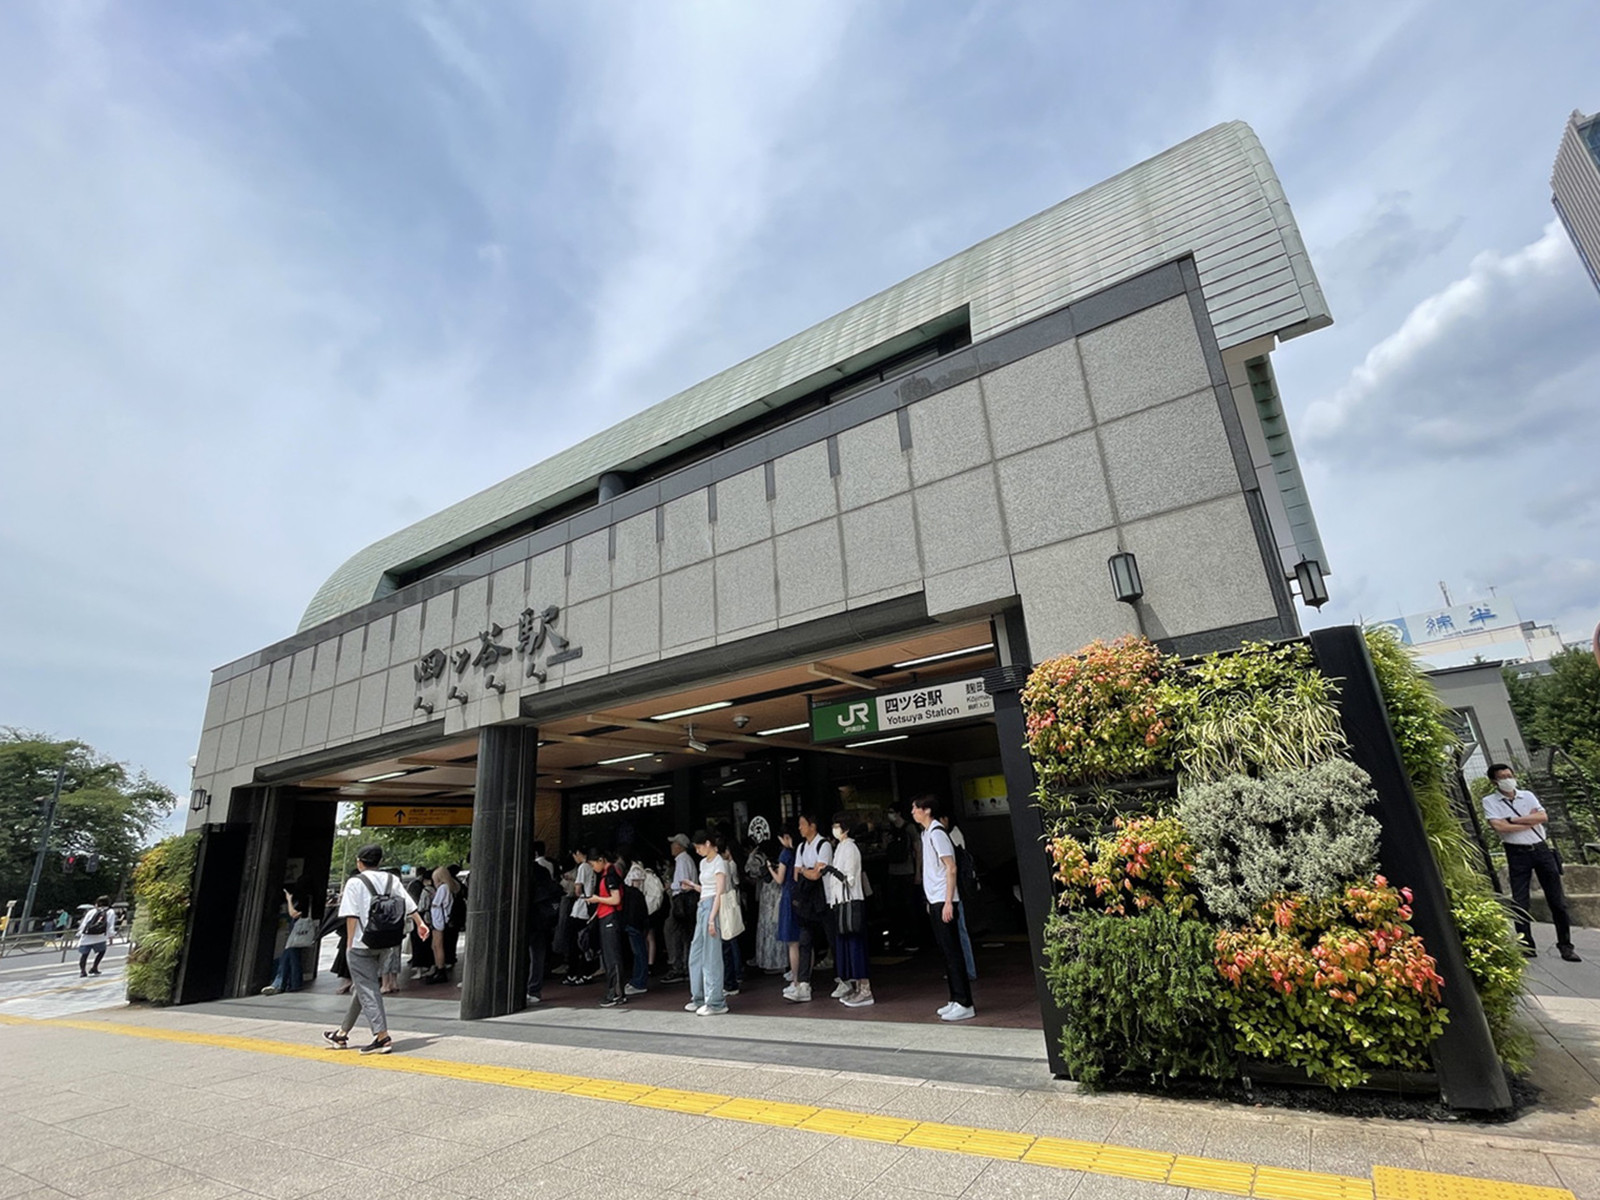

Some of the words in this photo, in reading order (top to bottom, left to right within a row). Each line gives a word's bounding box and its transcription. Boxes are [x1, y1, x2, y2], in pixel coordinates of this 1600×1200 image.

[414, 605, 570, 683] 四ツ谷駅
[885, 689, 943, 713] 四ツ谷駅
[838, 703, 870, 727] JR
[887, 713, 923, 726] Yotsuya
[925, 706, 960, 721] Station
[582, 799, 619, 816] BECK'S
[620, 792, 665, 811] COFFEE
